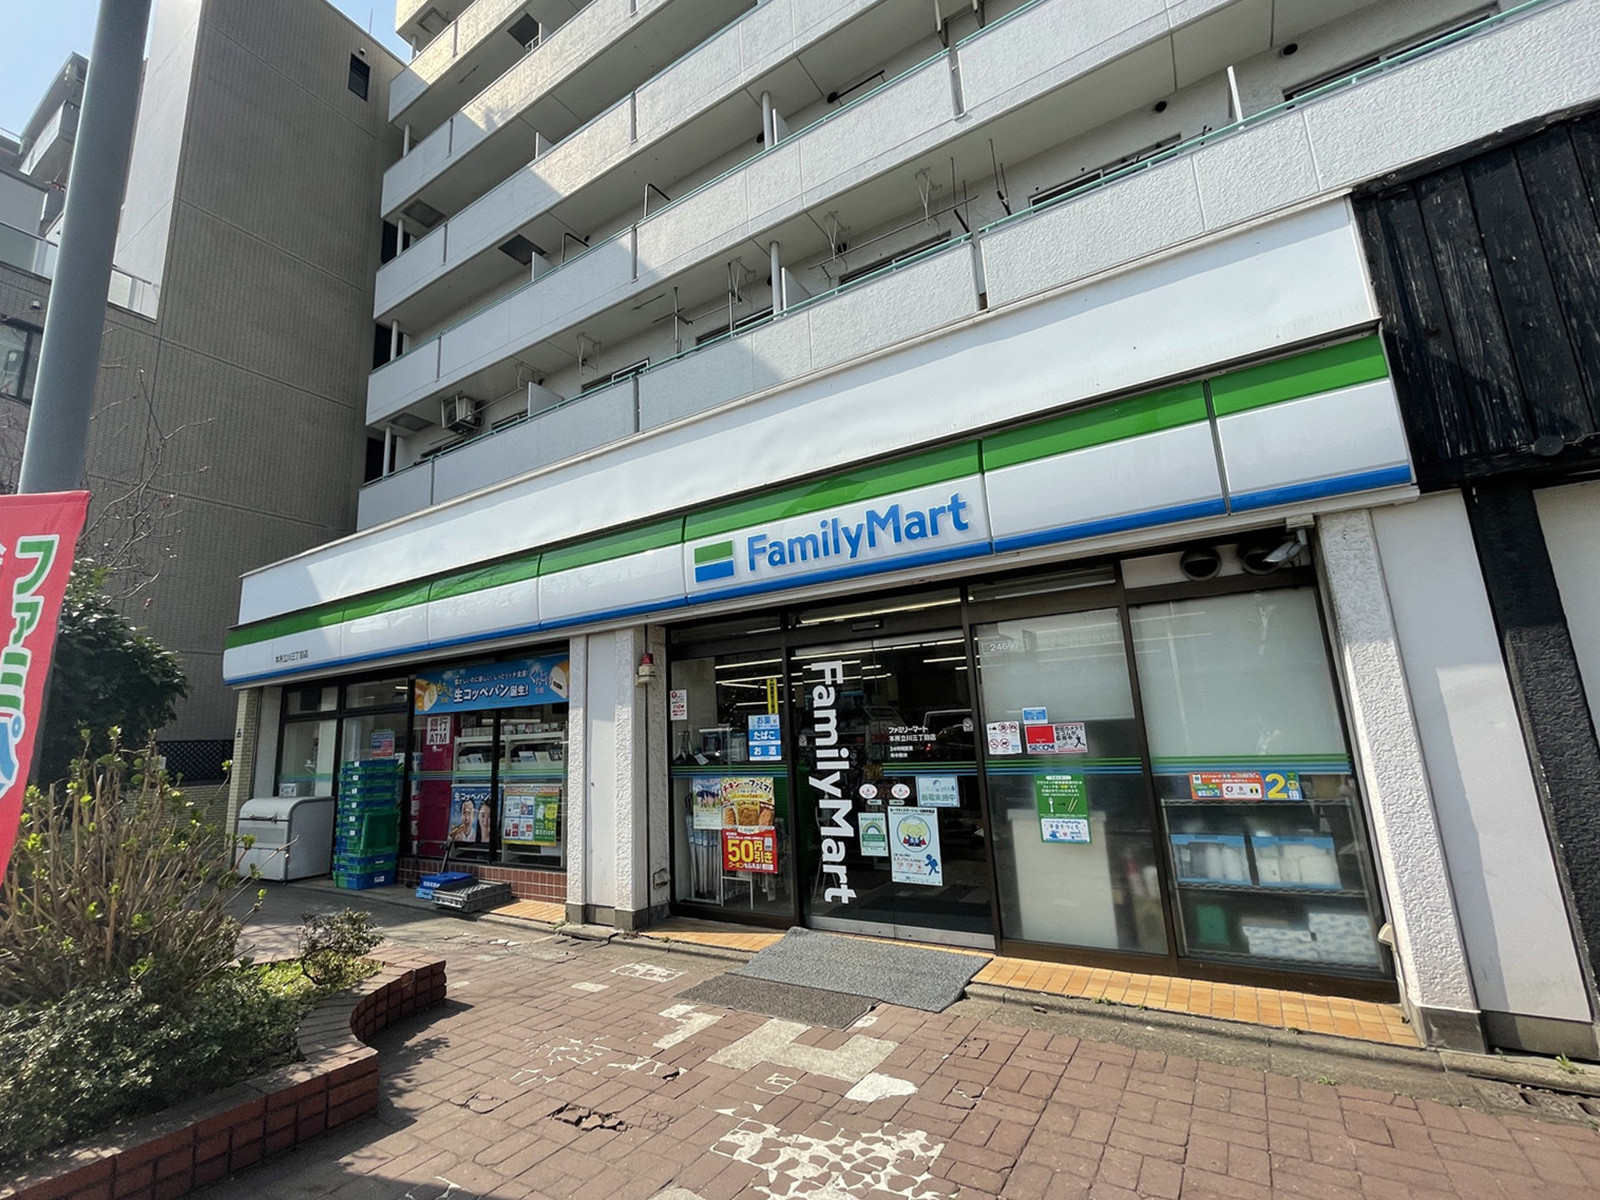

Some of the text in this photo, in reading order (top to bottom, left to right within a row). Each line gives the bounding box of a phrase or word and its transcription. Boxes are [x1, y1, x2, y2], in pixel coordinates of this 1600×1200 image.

[747, 492, 969, 572] FamilyMart
[430, 716, 448, 731] 銀行
[888, 725, 928, 734] ファミリーマート
[428, 732, 448, 744] ATM
[753, 730, 776, 740] たばこ
[1029, 744, 1054, 752] SECOM
[723, 781, 740, 793] チキン
[808, 660, 857, 904] FamilyMart
